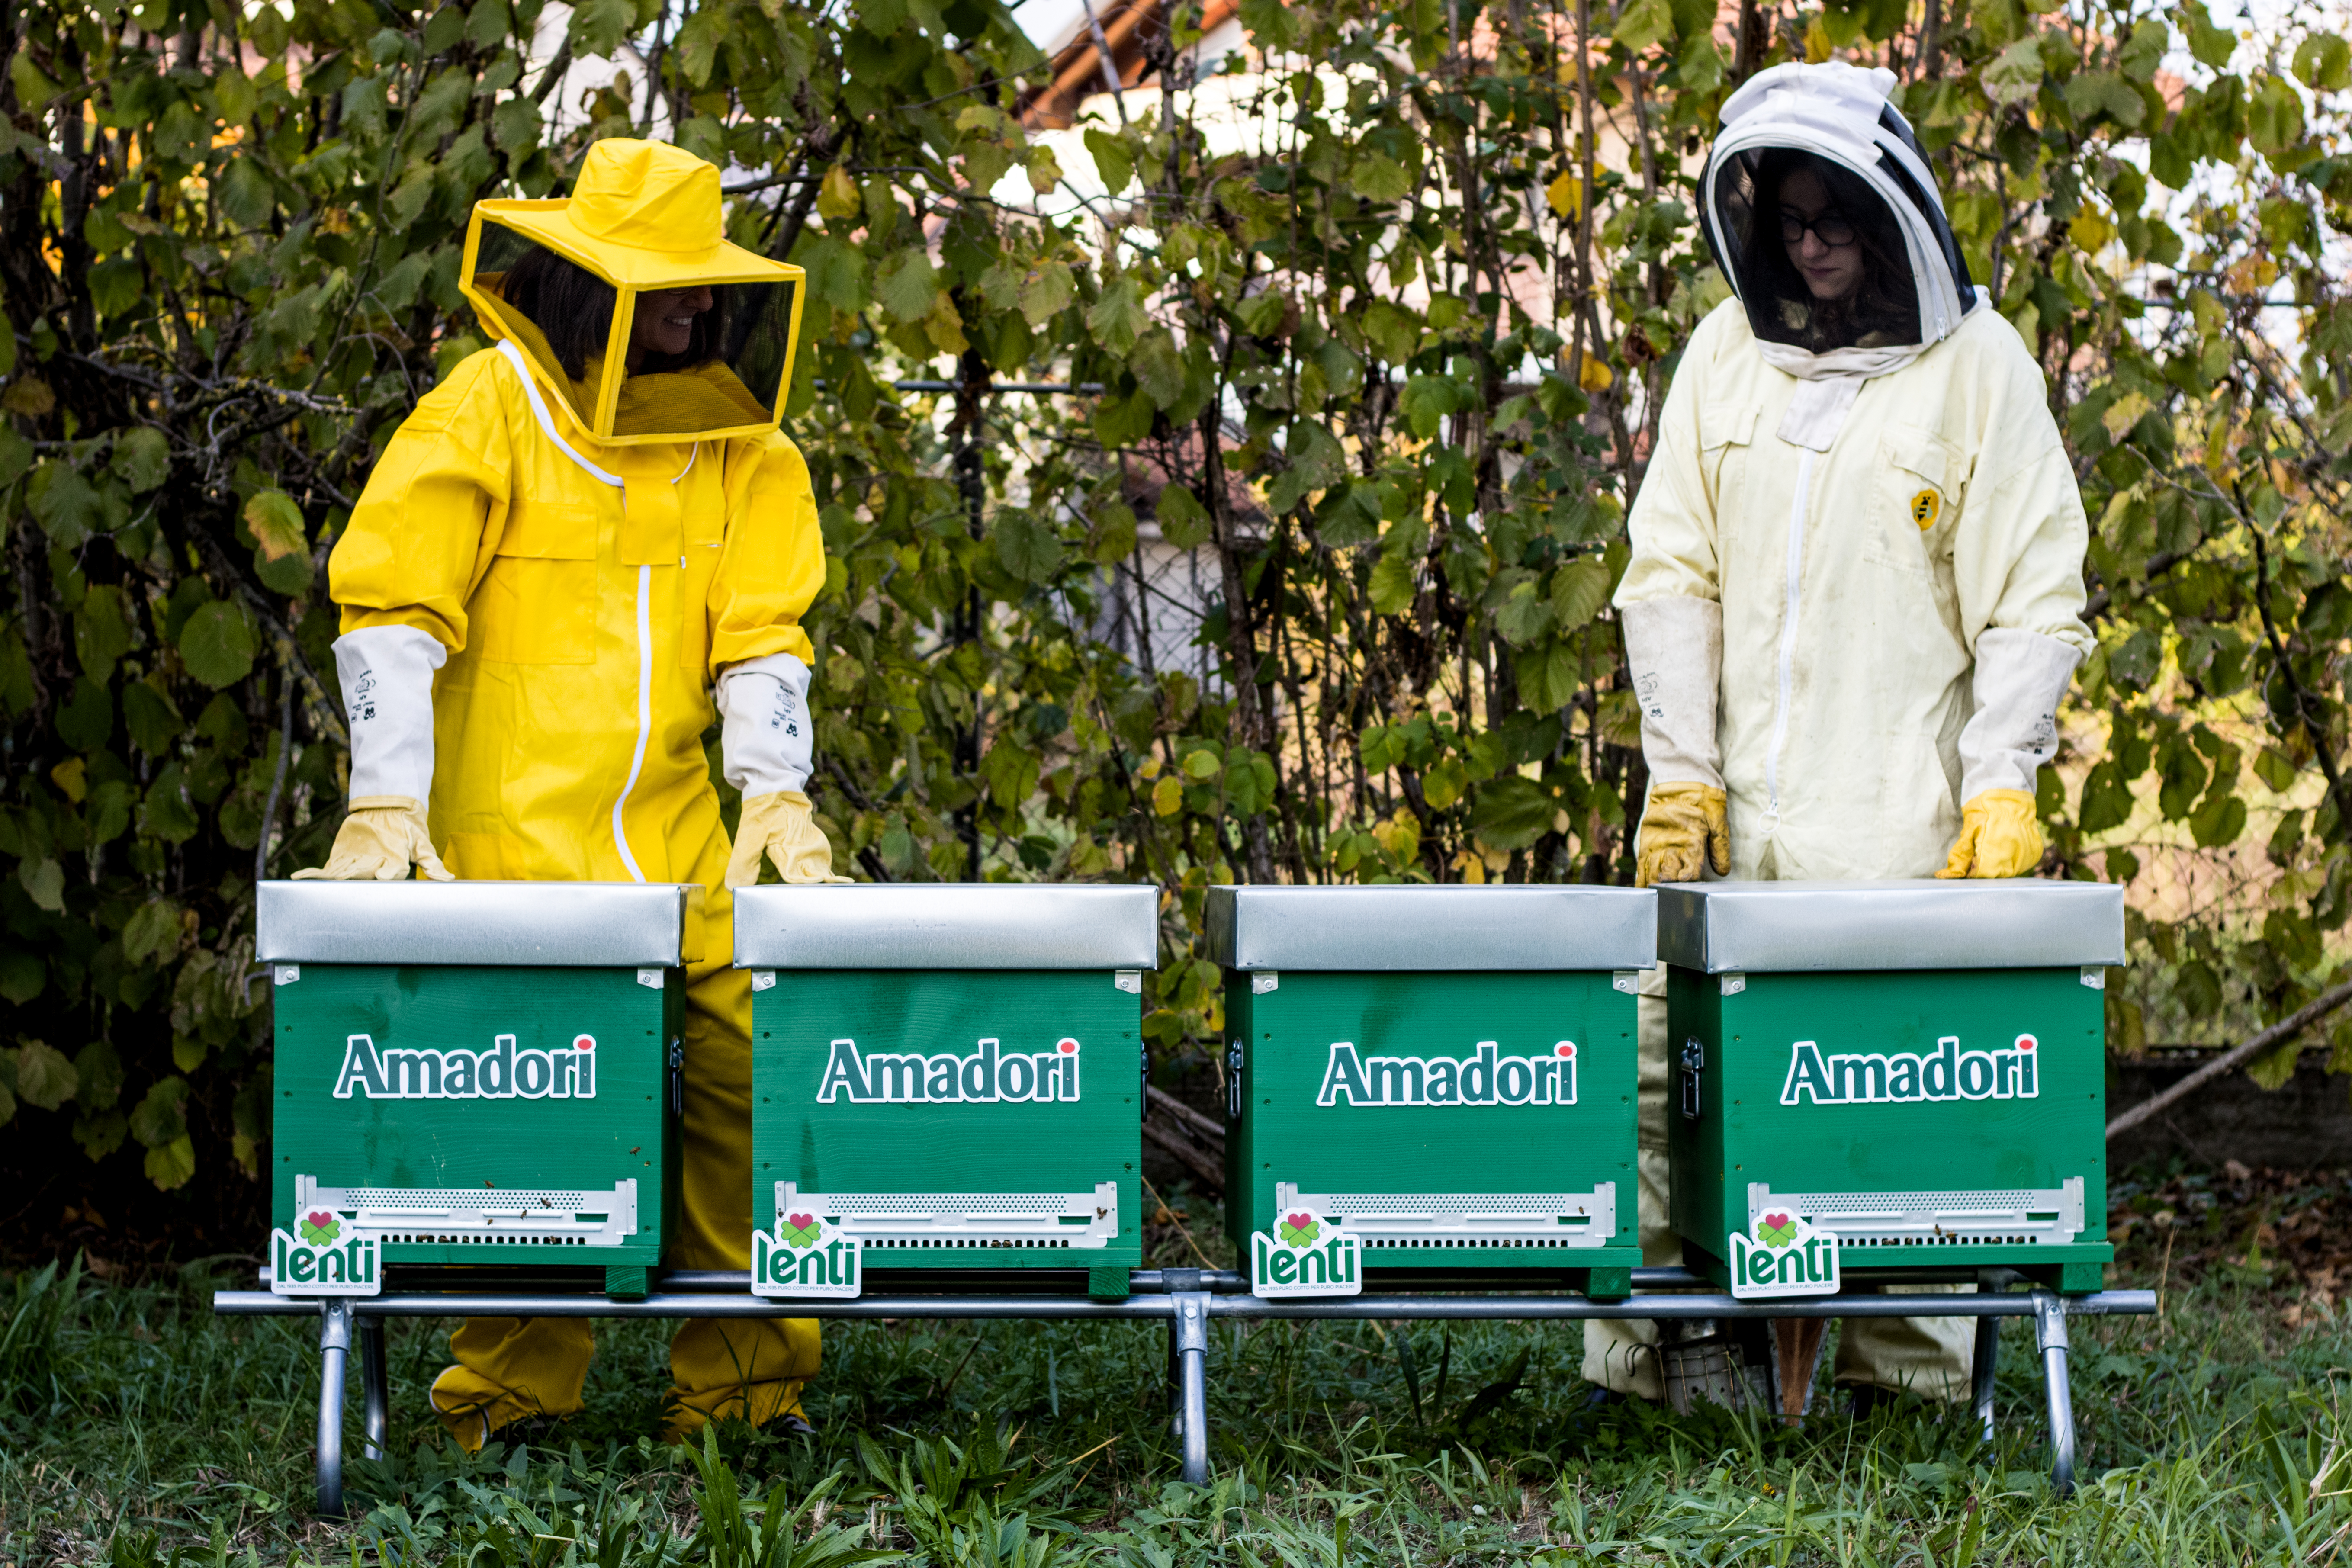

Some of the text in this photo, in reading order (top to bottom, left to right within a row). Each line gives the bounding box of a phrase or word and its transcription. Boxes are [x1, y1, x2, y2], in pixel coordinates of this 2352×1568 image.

[338, 1038, 592, 1095] Amadori
[821, 1041, 1076, 1099] Amadori
[1321, 1045, 1573, 1102] Amadori
[1784, 1038, 2034, 1102] Amadori
[277, 1234, 374, 1282] lenti
[758, 1236, 855, 1285] lenti
[1258, 1236, 1355, 1285] lenti
[1736, 1235, 1833, 1285] lenti
